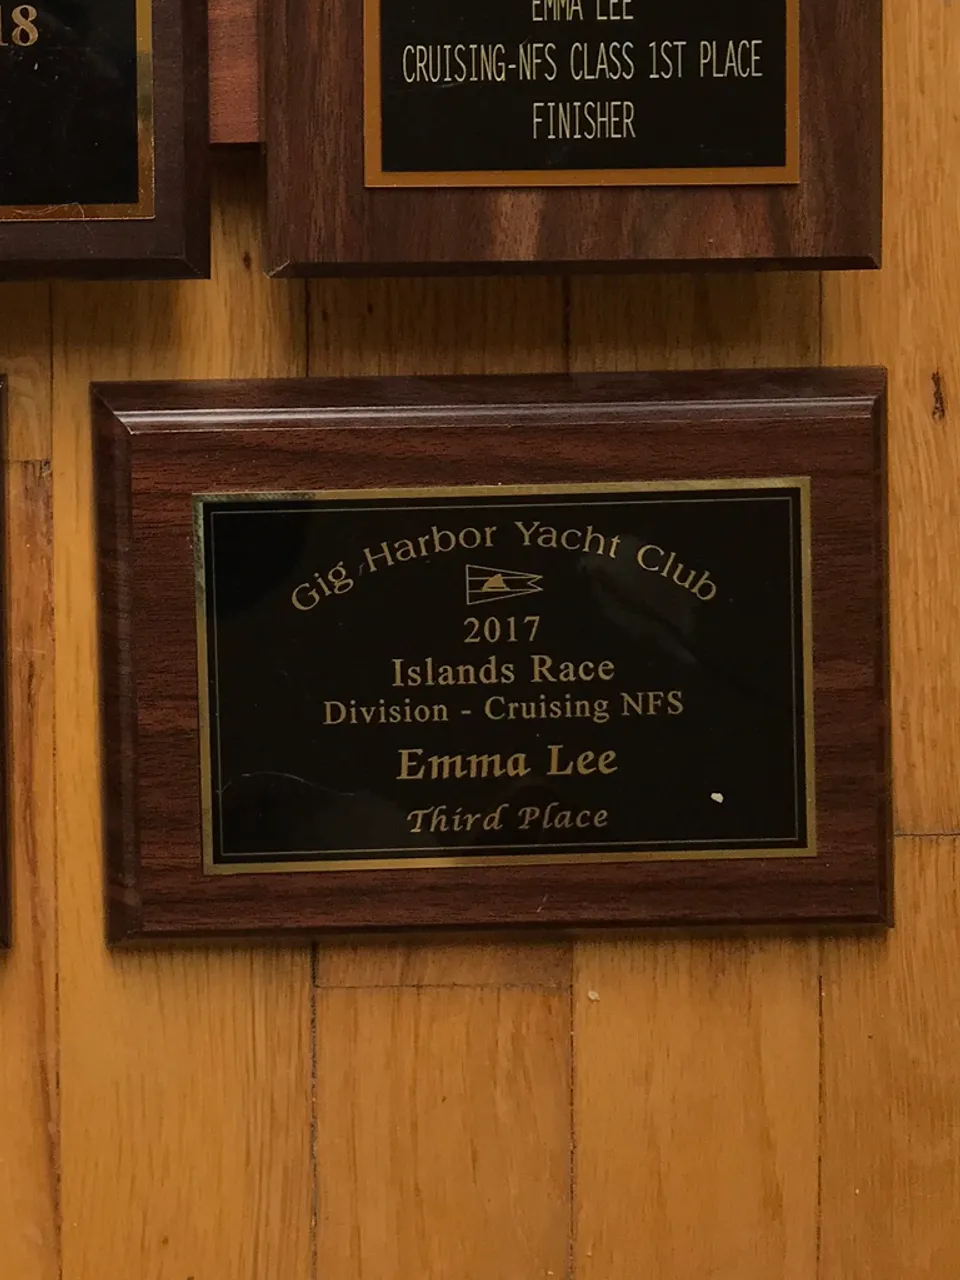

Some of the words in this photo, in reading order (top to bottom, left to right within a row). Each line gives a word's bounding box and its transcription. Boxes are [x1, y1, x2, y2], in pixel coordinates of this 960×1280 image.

[403, 43, 556, 82] CRUISING-NFS
[571, 42, 634, 80] CLASS
[649, 41, 686, 78] 1ST
[700, 40, 762, 77] PLACE
[534, 102, 635, 139] FINISHER
[292, 562, 353, 610] Gig
[362, 525, 497, 573] Harbor
[515, 522, 620, 558] Yacht
[636, 544, 719, 602] Club
[464, 616, 539, 642] 2017
[392, 656, 514, 686] Islands
[531, 655, 614, 682] Race
[323, 699, 448, 724] Division
[485, 694, 609, 723] Cruising
[621, 691, 683, 715] NFS
[396, 749, 531, 779] Emma
[547, 745, 617, 775] Lee
[407, 804, 509, 832] Third
[518, 803, 608, 829] Place
